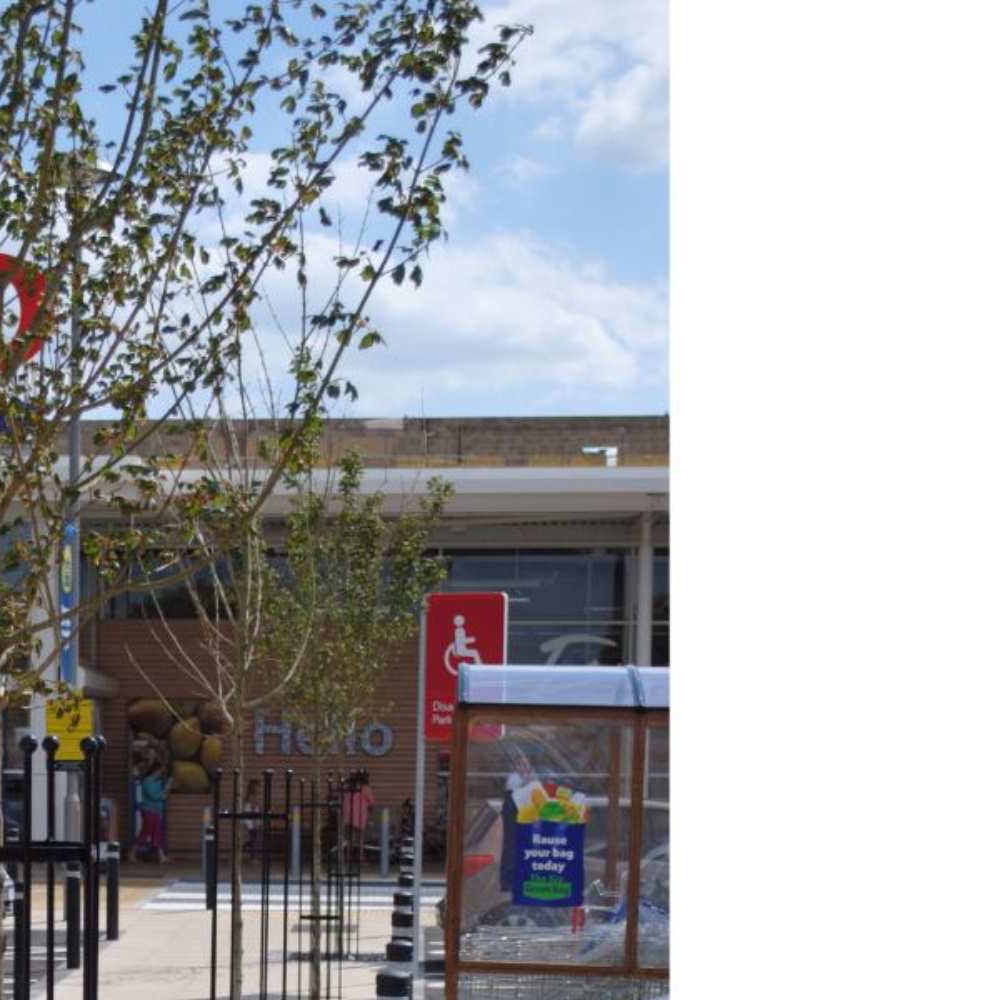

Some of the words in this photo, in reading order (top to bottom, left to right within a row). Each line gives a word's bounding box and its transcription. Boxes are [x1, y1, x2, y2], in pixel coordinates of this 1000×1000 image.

[523, 848, 550, 860] your
[552, 846, 574, 861] bag
[531, 860, 566, 874] today
